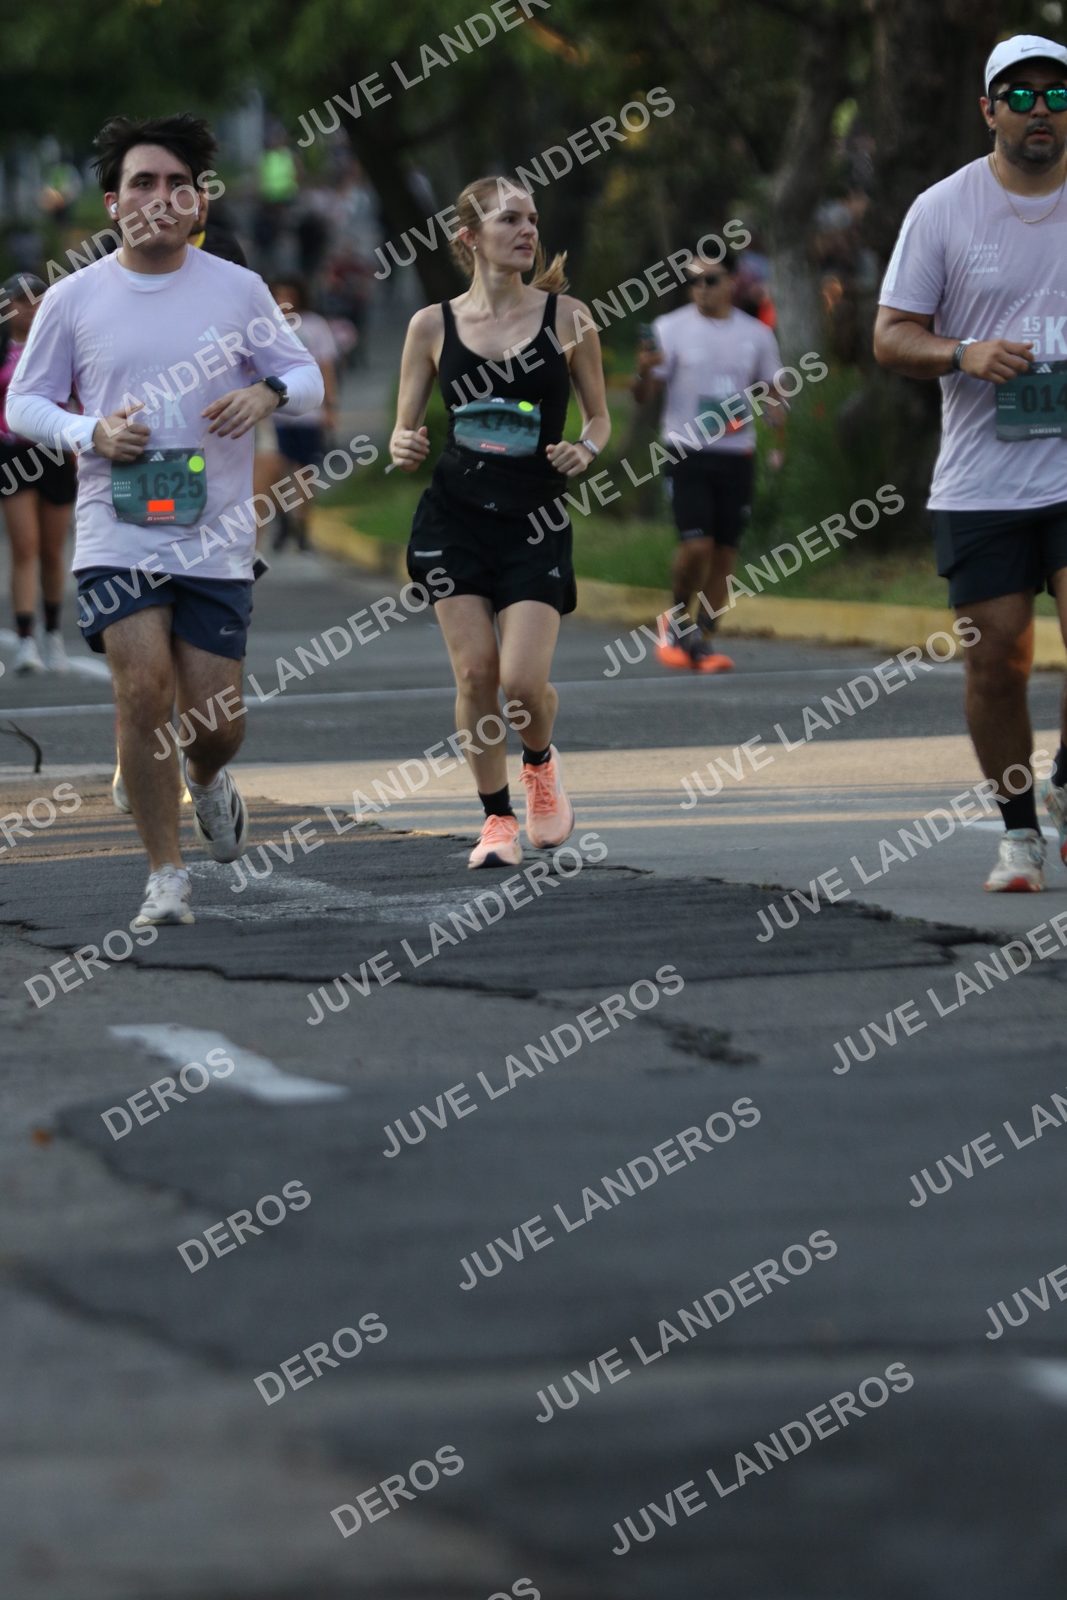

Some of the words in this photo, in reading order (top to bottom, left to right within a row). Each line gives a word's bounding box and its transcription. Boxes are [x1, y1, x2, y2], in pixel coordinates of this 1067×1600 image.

[1022, 316, 1041, 332] 15
[1046, 316, 1067, 354] K
[1022, 339, 1041, 355] 0
[137, 471, 203, 501] 1625
